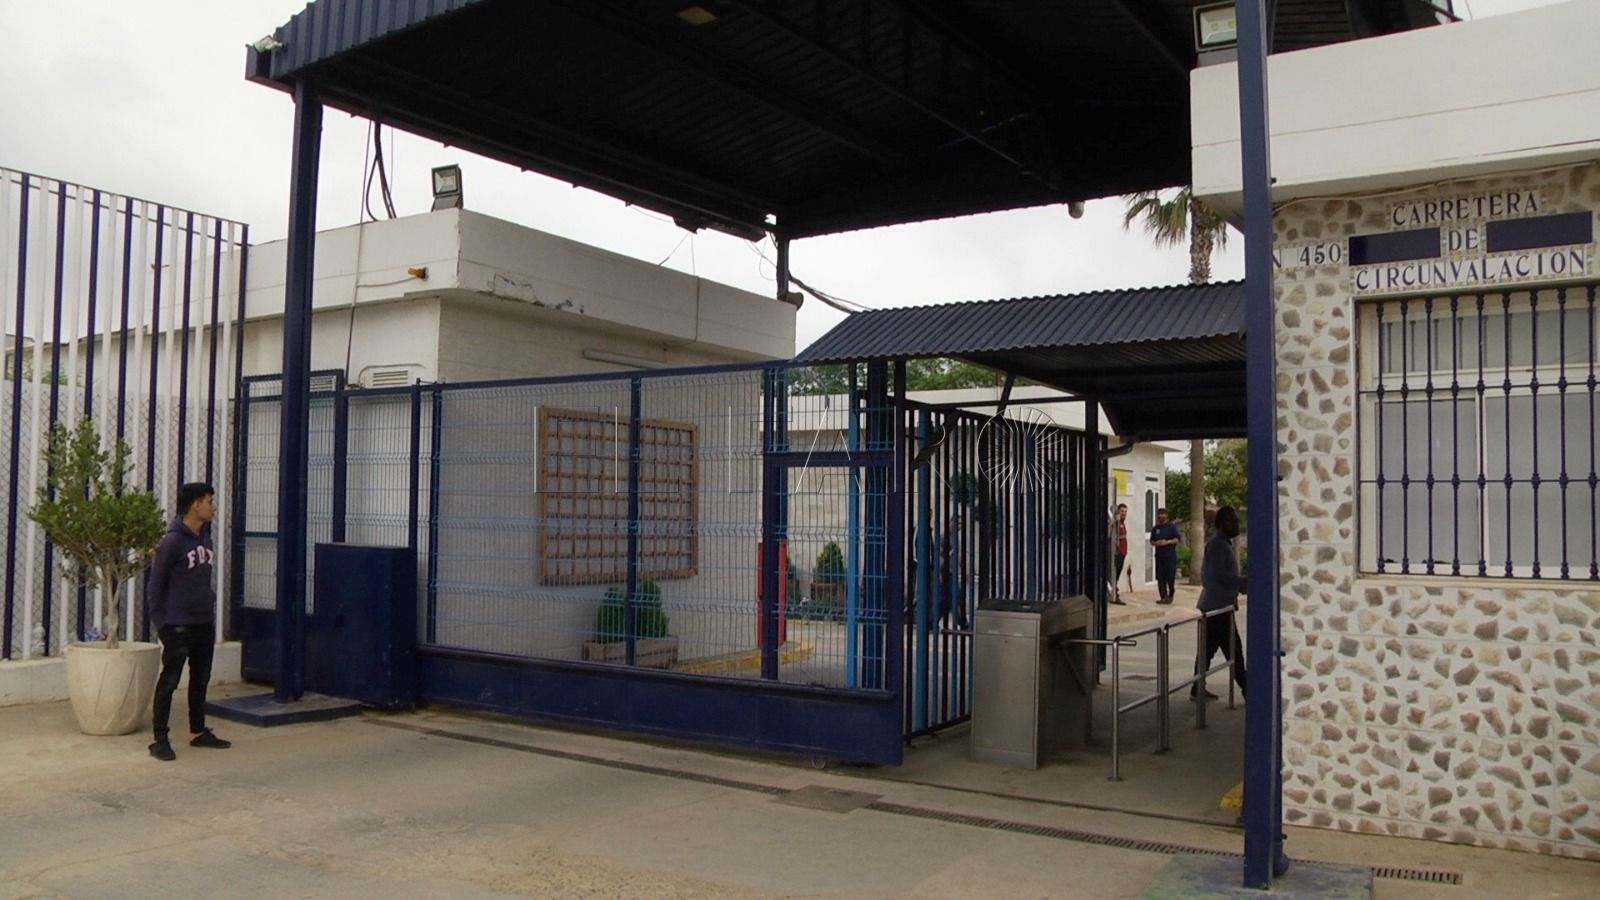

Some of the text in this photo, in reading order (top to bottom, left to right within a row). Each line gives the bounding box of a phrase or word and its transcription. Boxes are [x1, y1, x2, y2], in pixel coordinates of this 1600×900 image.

[1392, 193, 1539, 226] CARRETERA
[1448, 227, 1480, 251] DE
[1300, 243, 1341, 266] 450
[1356, 250, 1586, 290] CIRCUNVALACION
